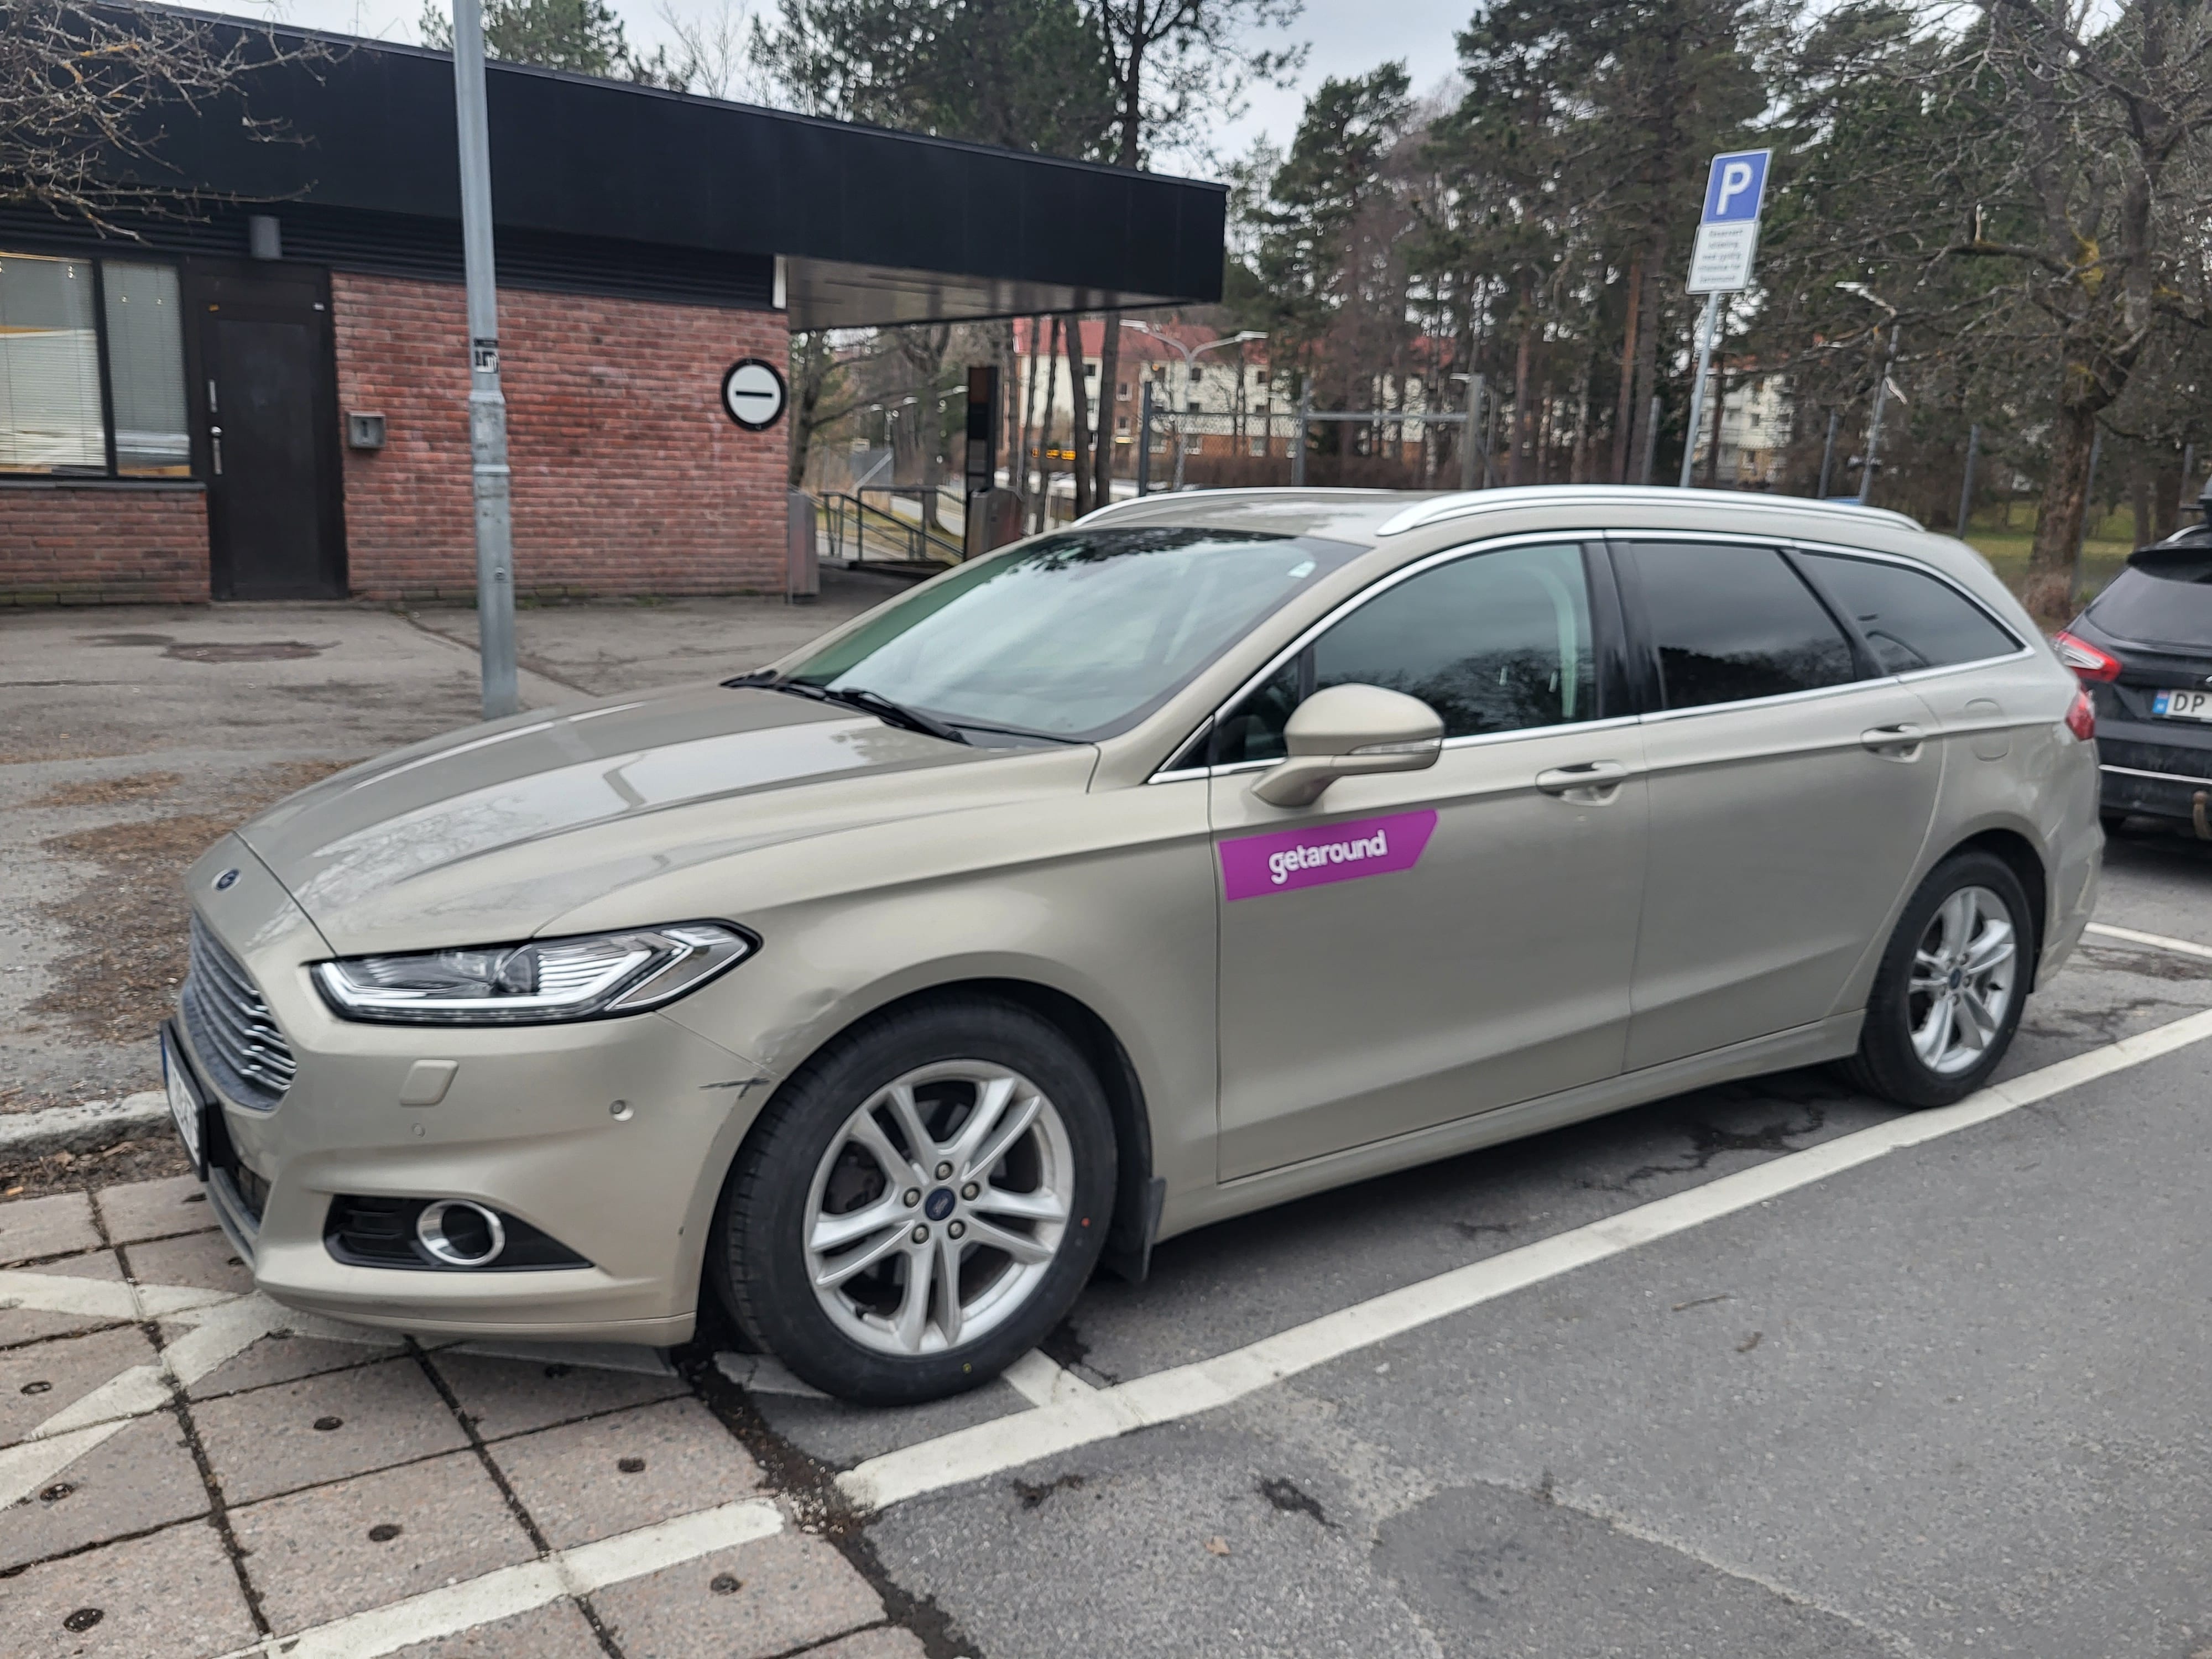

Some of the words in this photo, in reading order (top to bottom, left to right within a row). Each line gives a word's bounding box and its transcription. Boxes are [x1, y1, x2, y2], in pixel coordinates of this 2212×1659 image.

[1716, 161, 1753, 215] P
[2173, 693, 2205, 712] DP
[1269, 829, 1387, 884] getaround
